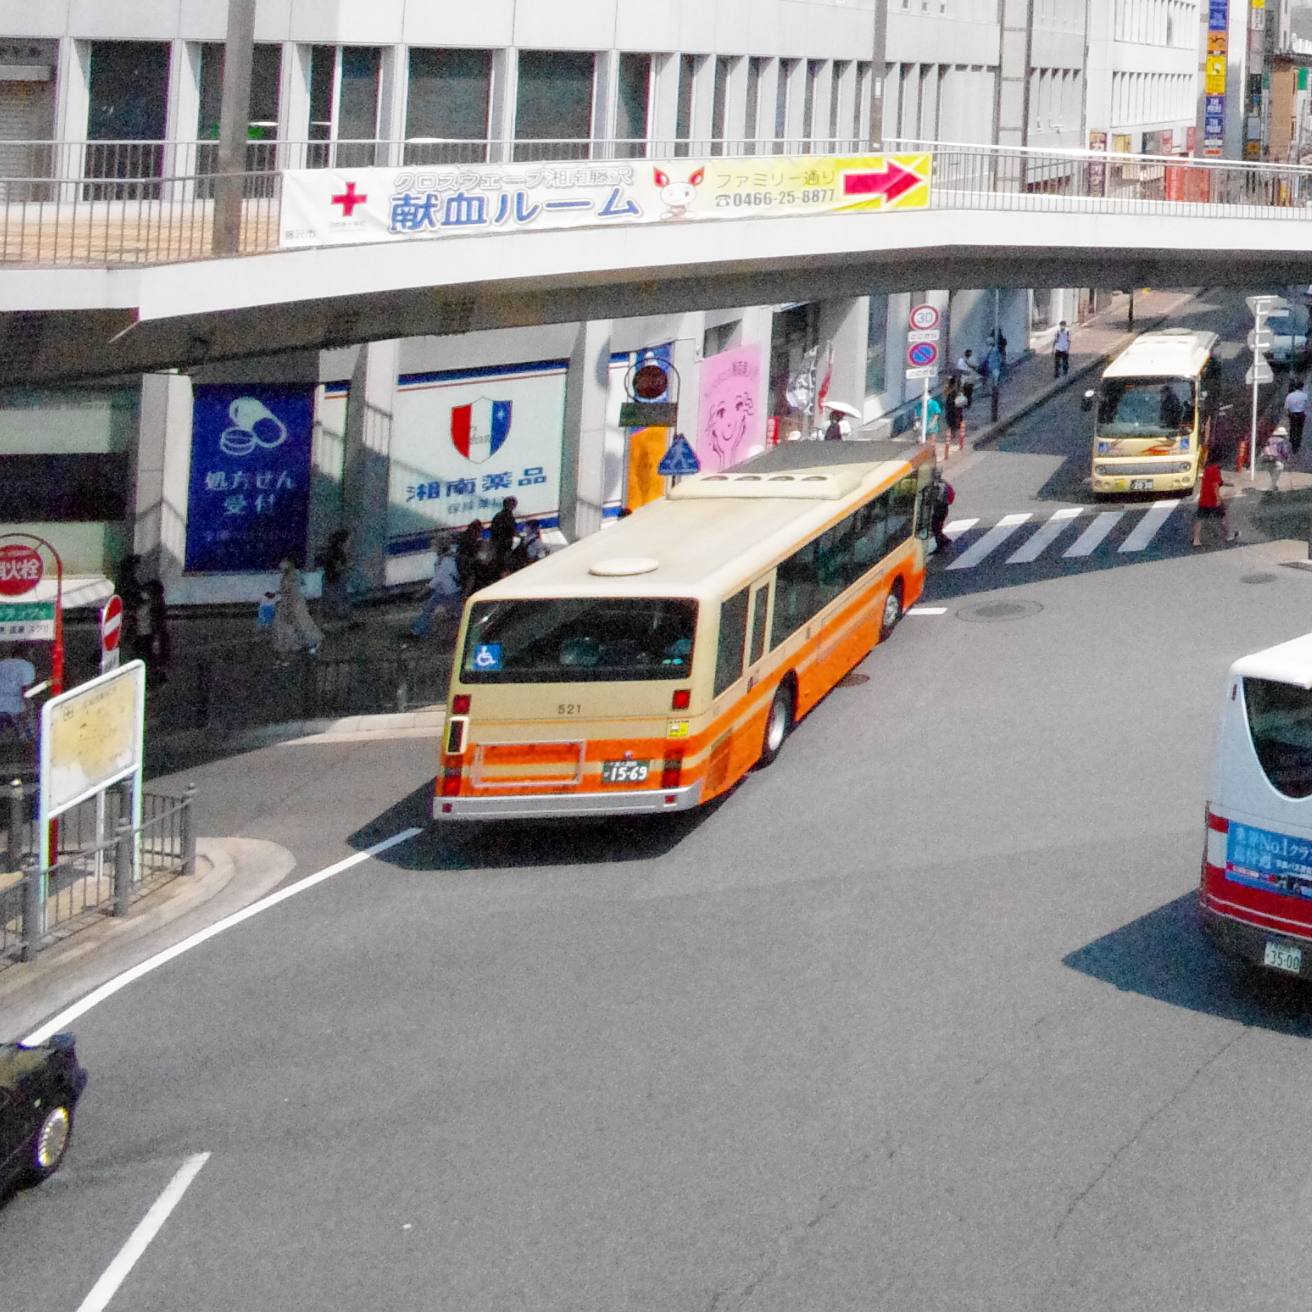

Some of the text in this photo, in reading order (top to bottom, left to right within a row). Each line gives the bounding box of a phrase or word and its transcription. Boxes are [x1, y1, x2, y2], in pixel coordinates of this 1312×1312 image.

[716, 171, 835, 187] ファミリー通り
[733, 189, 835, 206] 0466-25-8877
[391, 188, 640, 231] 献血ルーム
[916, 311, 934, 324] 30
[205, 471, 294, 492] 処方せん
[406, 466, 547, 503] 湘南薬品
[223, 495, 277, 516] 受付
[558, 704, 581, 714] 521
[610, 766, 648, 781] 15-69
[1271, 950, 1299, 970] 35-00
